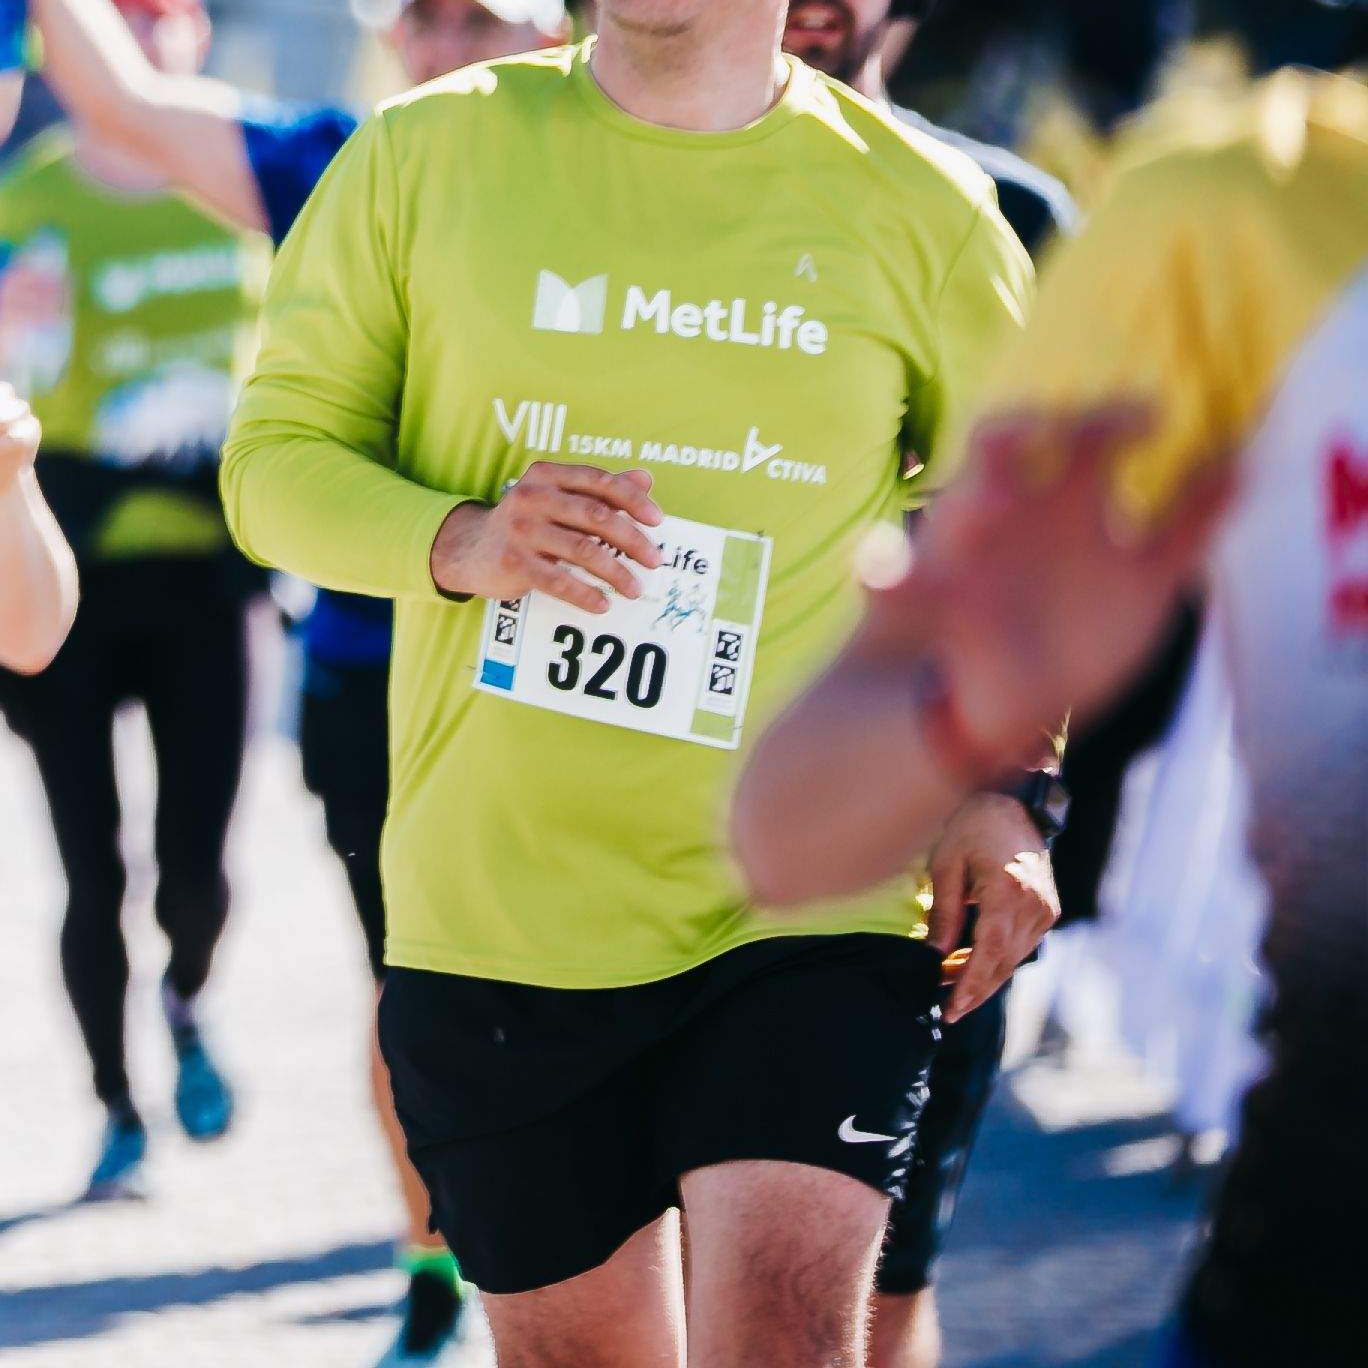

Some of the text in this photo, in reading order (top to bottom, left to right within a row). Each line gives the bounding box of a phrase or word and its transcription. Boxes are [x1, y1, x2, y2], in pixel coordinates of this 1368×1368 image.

[621, 285, 828, 355] MetLife
[493, 398, 568, 452] VIII
[568, 435, 632, 459] 15KM
[547, 624, 668, 709] 320
